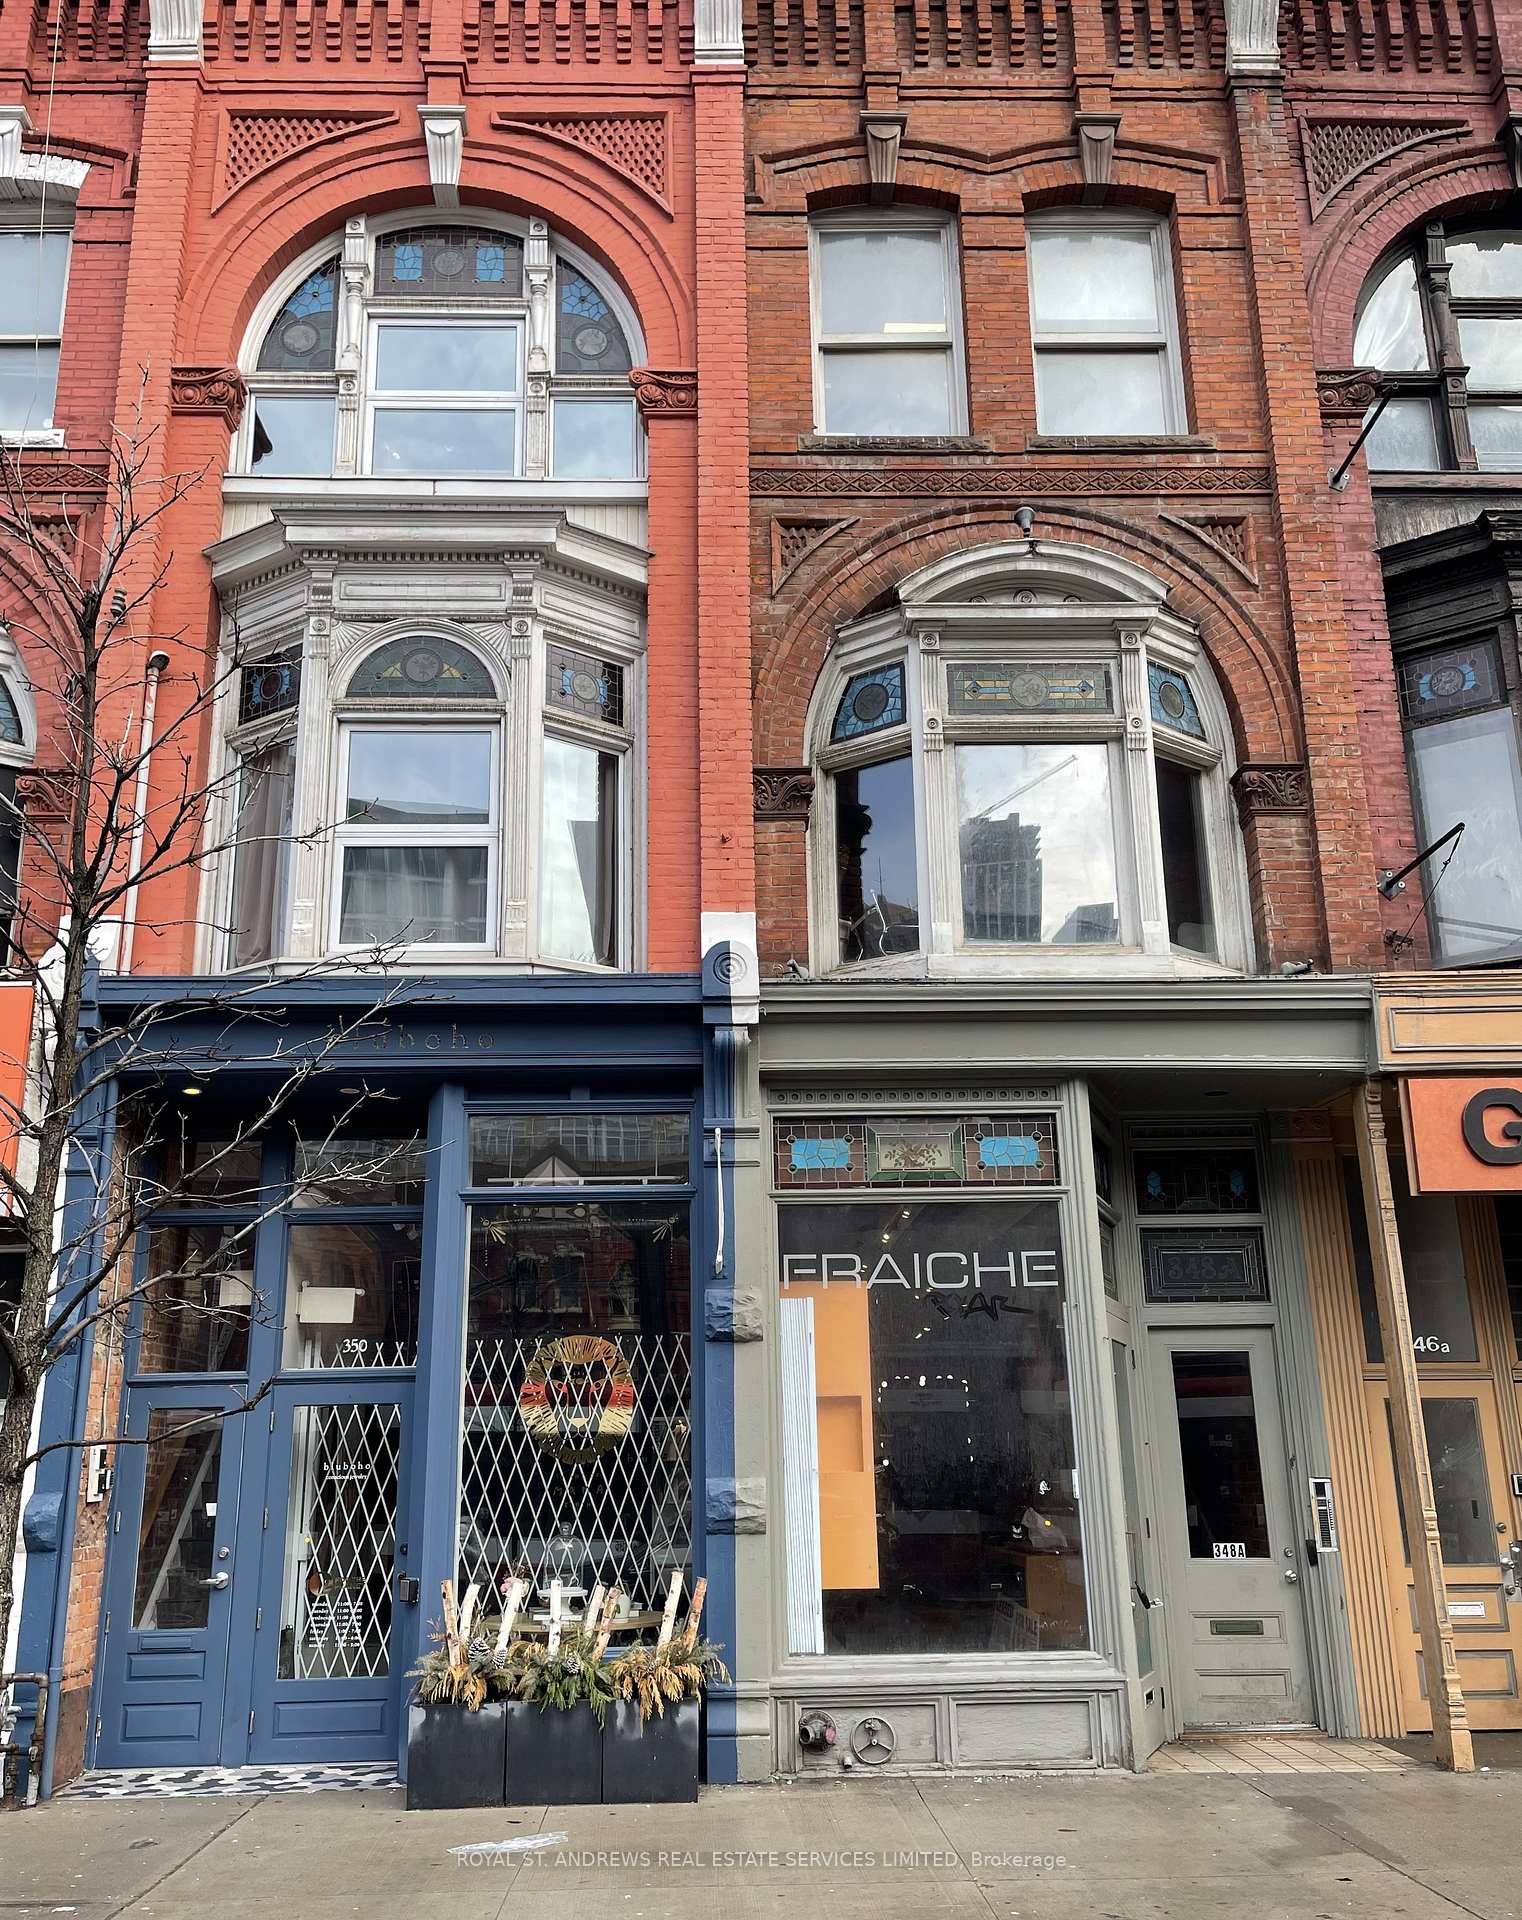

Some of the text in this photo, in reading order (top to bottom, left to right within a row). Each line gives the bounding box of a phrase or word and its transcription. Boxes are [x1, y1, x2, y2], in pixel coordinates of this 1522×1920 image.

[783, 1250, 1058, 1290] FRAICHE
[342, 1338, 368, 1353] 350
[323, 1461, 371, 1471] bluboho
[1214, 1544, 1246, 1558] 348A
